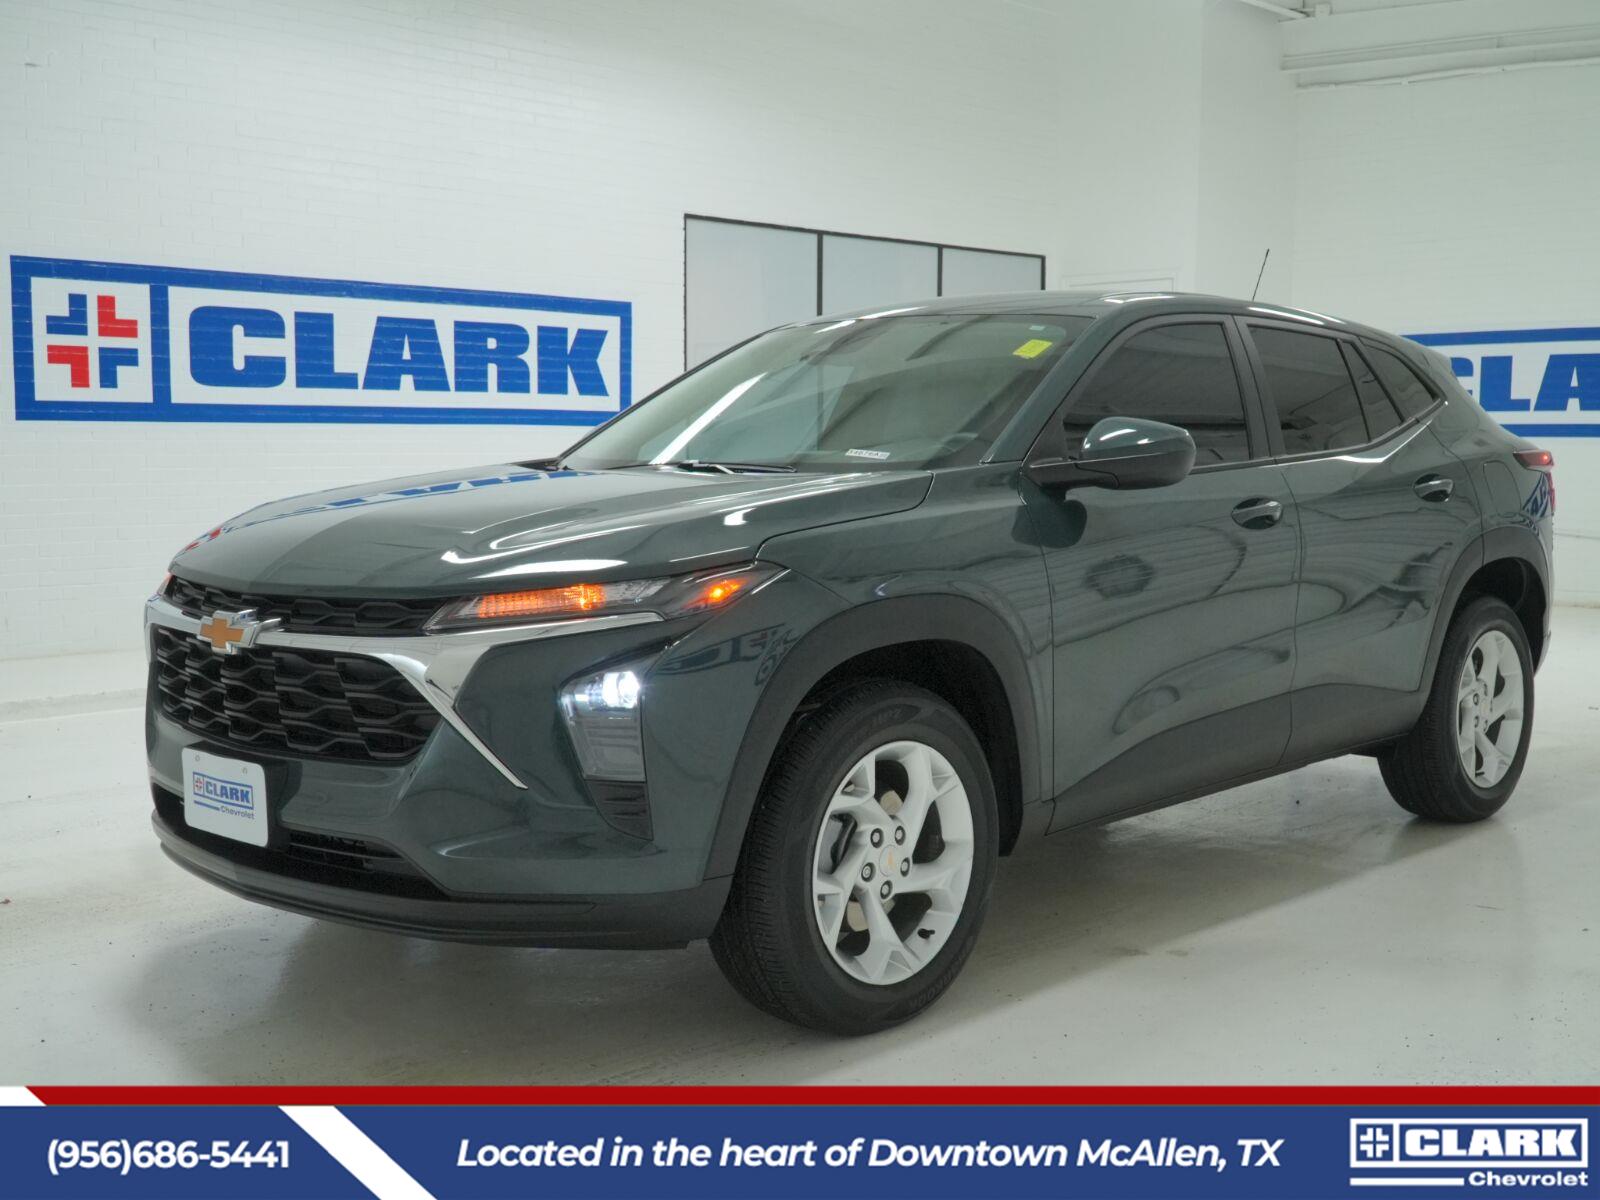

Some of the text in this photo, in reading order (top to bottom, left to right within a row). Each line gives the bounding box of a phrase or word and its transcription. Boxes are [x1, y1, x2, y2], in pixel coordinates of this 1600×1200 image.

[188, 305, 609, 398] CLARK
[205, 781, 251, 804] CLARK
[220, 805, 255, 820] Chevrolet
